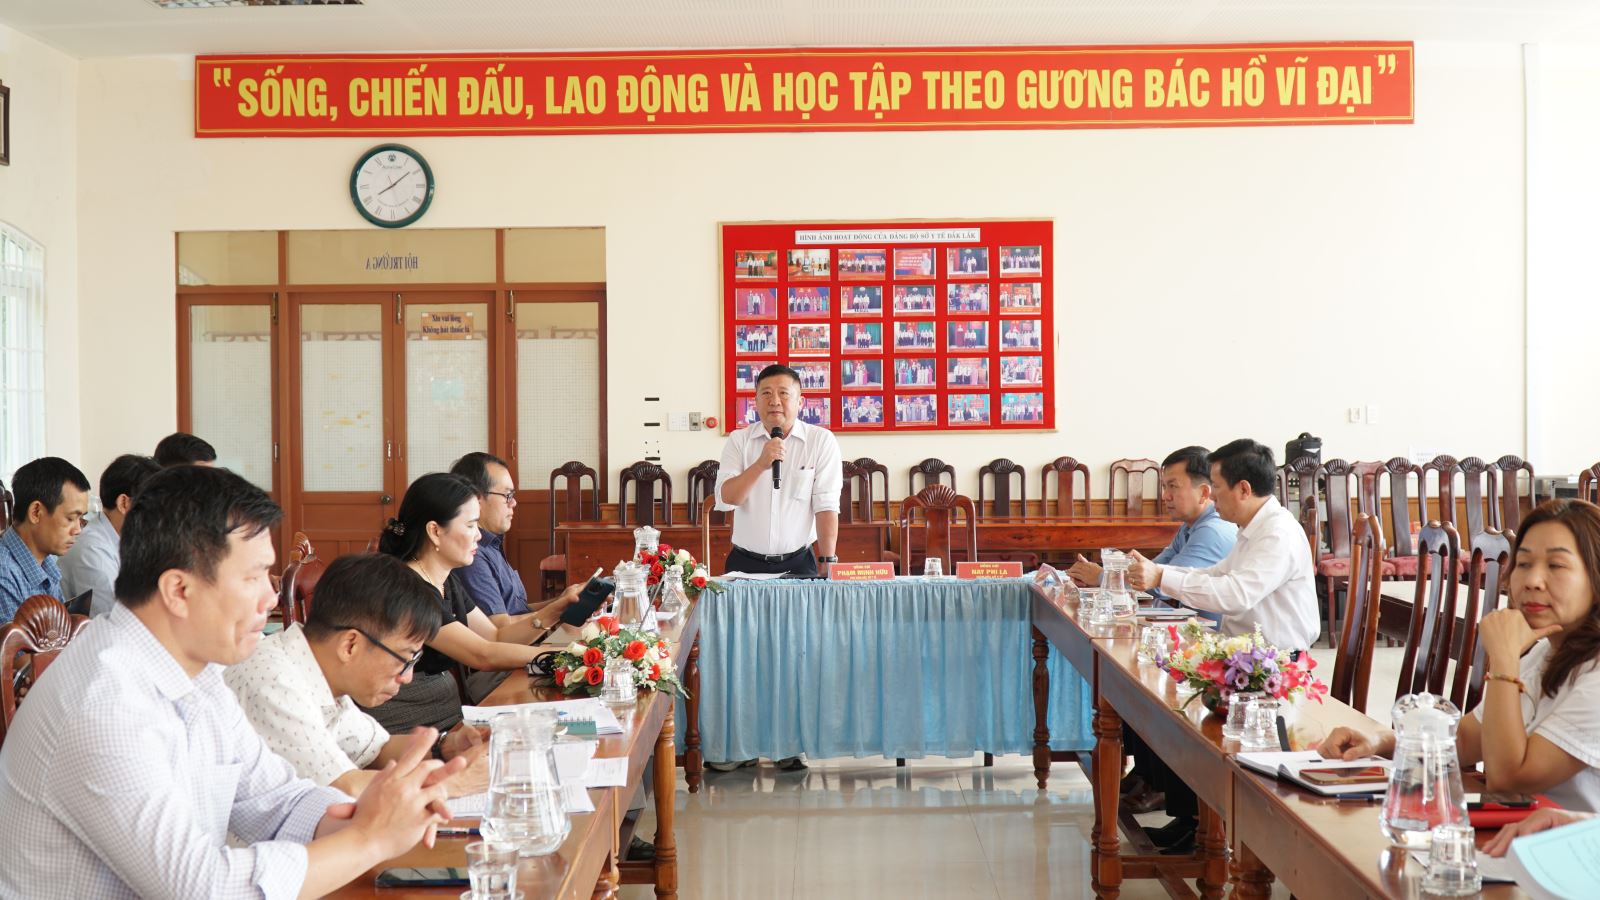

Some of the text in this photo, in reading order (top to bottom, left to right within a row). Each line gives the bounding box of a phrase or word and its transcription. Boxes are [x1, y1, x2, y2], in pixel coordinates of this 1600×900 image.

[350, 62, 446, 115] CHIẾN
[457, 62, 535, 119] ĐẤU,
[547, 75, 606, 114] LAO
[616, 64, 708, 121] ĐỘNG
[721, 63, 761, 112] VÀ
[773, 72, 839, 119] HỌC
[850, 62, 911, 119] TẬP
[923, 70, 1005, 110] THEO
[1017, 68, 1133, 109] GƯƠNG
[1145, 58, 1210, 107] BÁC
[1221, 55, 1267, 107] HỒ
[1275, 57, 1308, 105] VĨ
